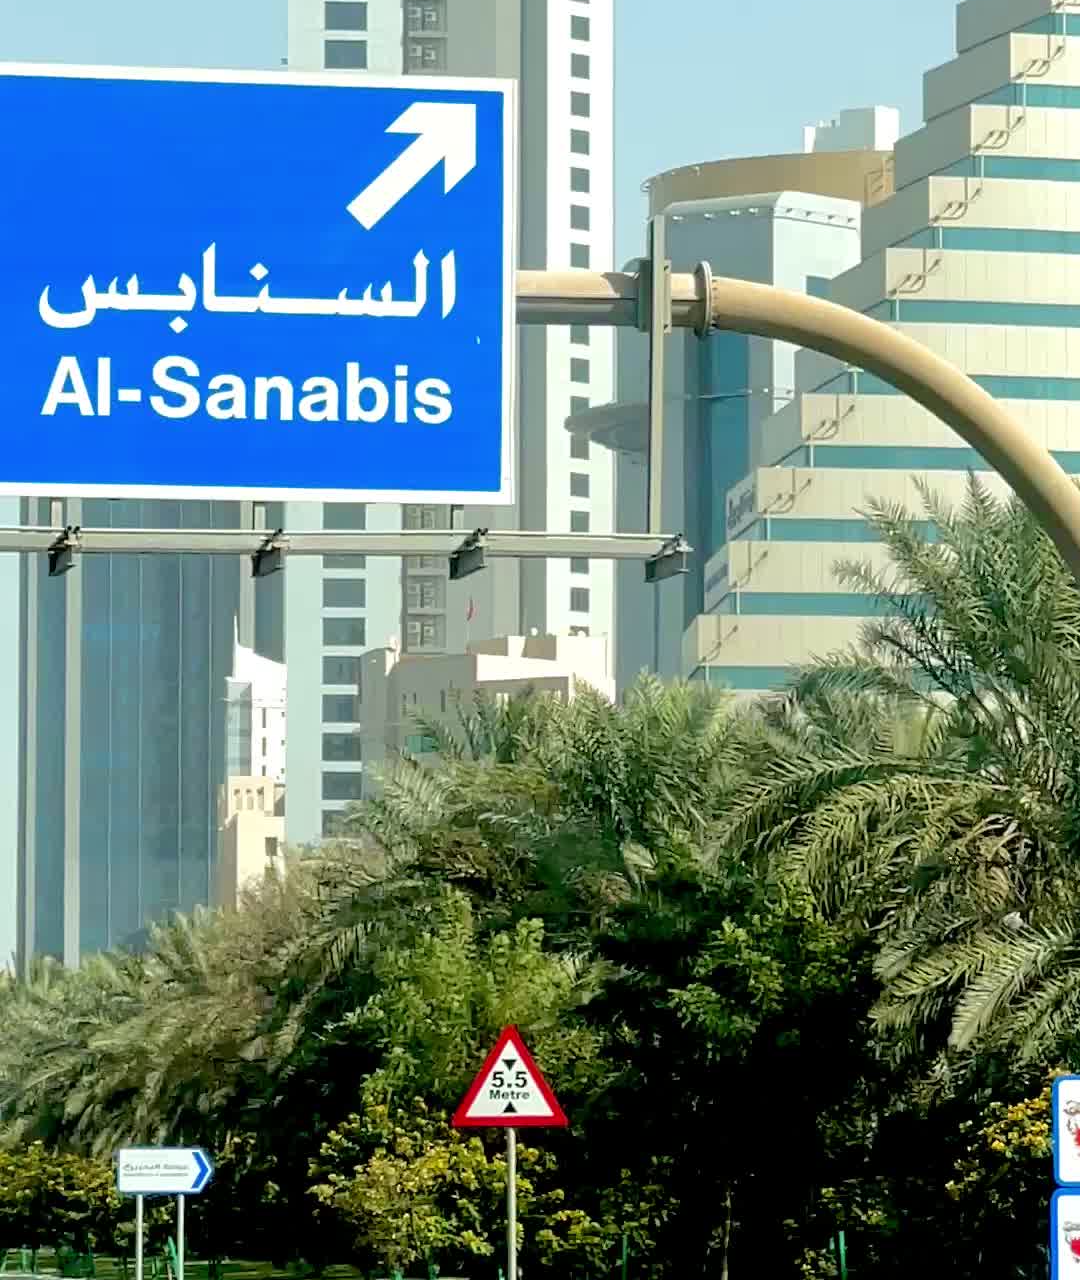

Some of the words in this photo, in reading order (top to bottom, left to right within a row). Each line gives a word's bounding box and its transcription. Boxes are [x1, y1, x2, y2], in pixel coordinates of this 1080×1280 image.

[38, 240, 457, 334] السنابس
[39, 355, 453, 425] Al-Sanabis
[489, 1089, 530, 1100] Metre
[491, 1071, 528, 1089] 5.5
